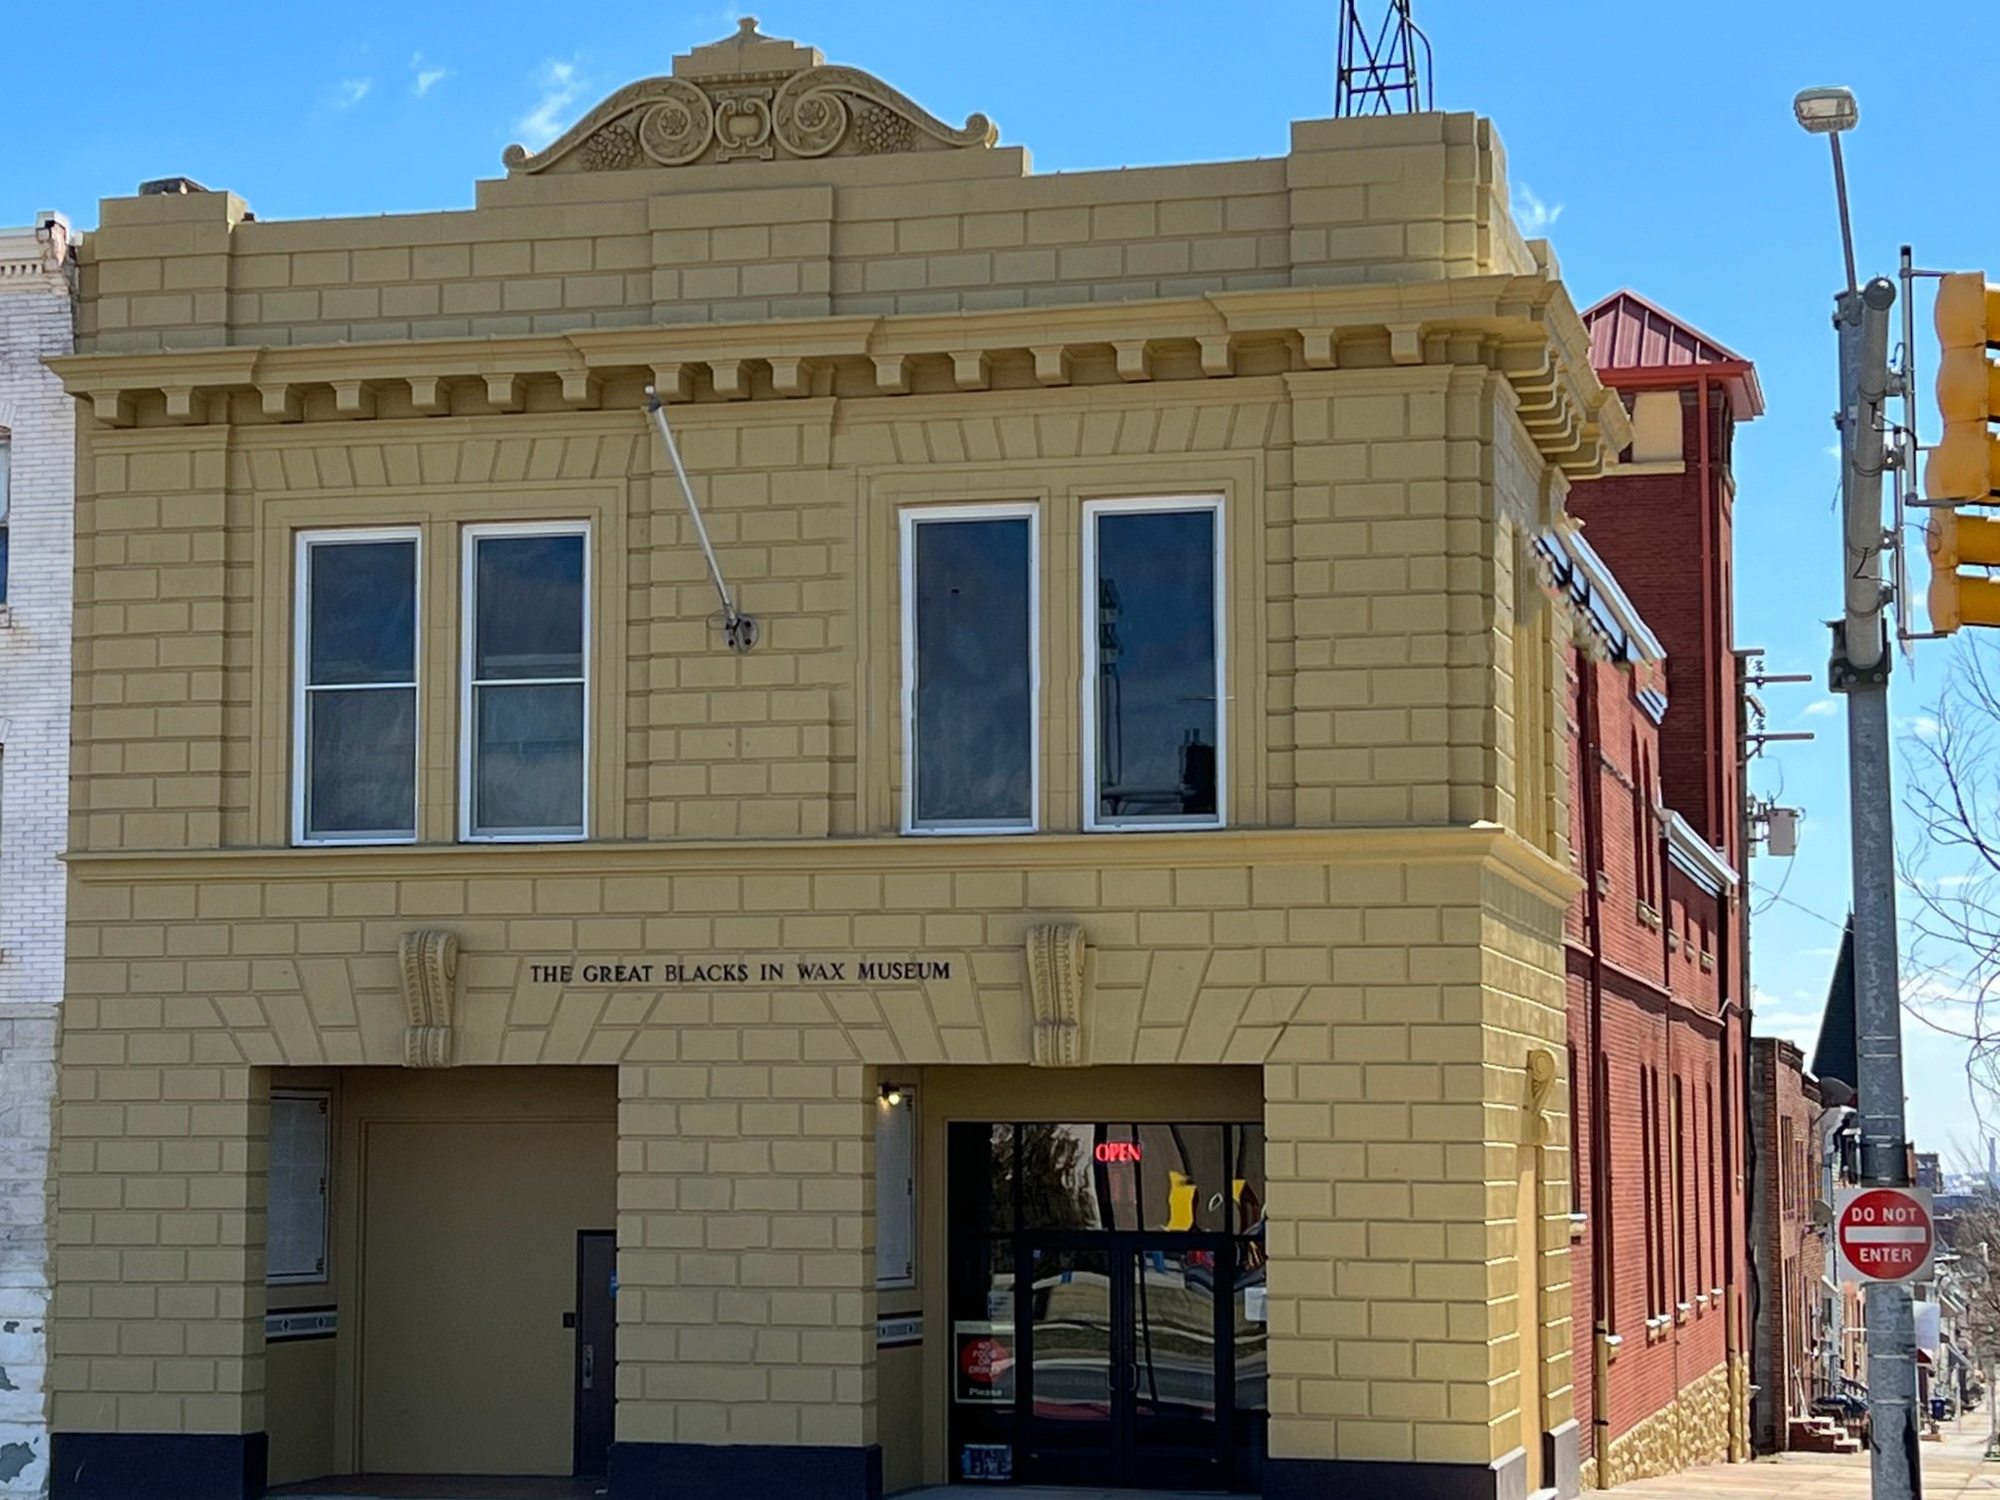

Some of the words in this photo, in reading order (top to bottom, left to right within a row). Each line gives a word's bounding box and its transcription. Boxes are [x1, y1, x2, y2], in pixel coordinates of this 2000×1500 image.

[530, 965, 572, 983] THE
[583, 965, 653, 983] GREAT
[665, 964, 748, 983] BLACKS
[760, 963, 784, 981] IN
[796, 963, 845, 981] WAX
[858, 962, 950, 981] MUSEUM
[1095, 1143, 1141, 1162] OPEN
[1851, 1207, 1875, 1222] DO
[1882, 1207, 1917, 1222] NOT
[1859, 1248, 1912, 1262] ENTER
